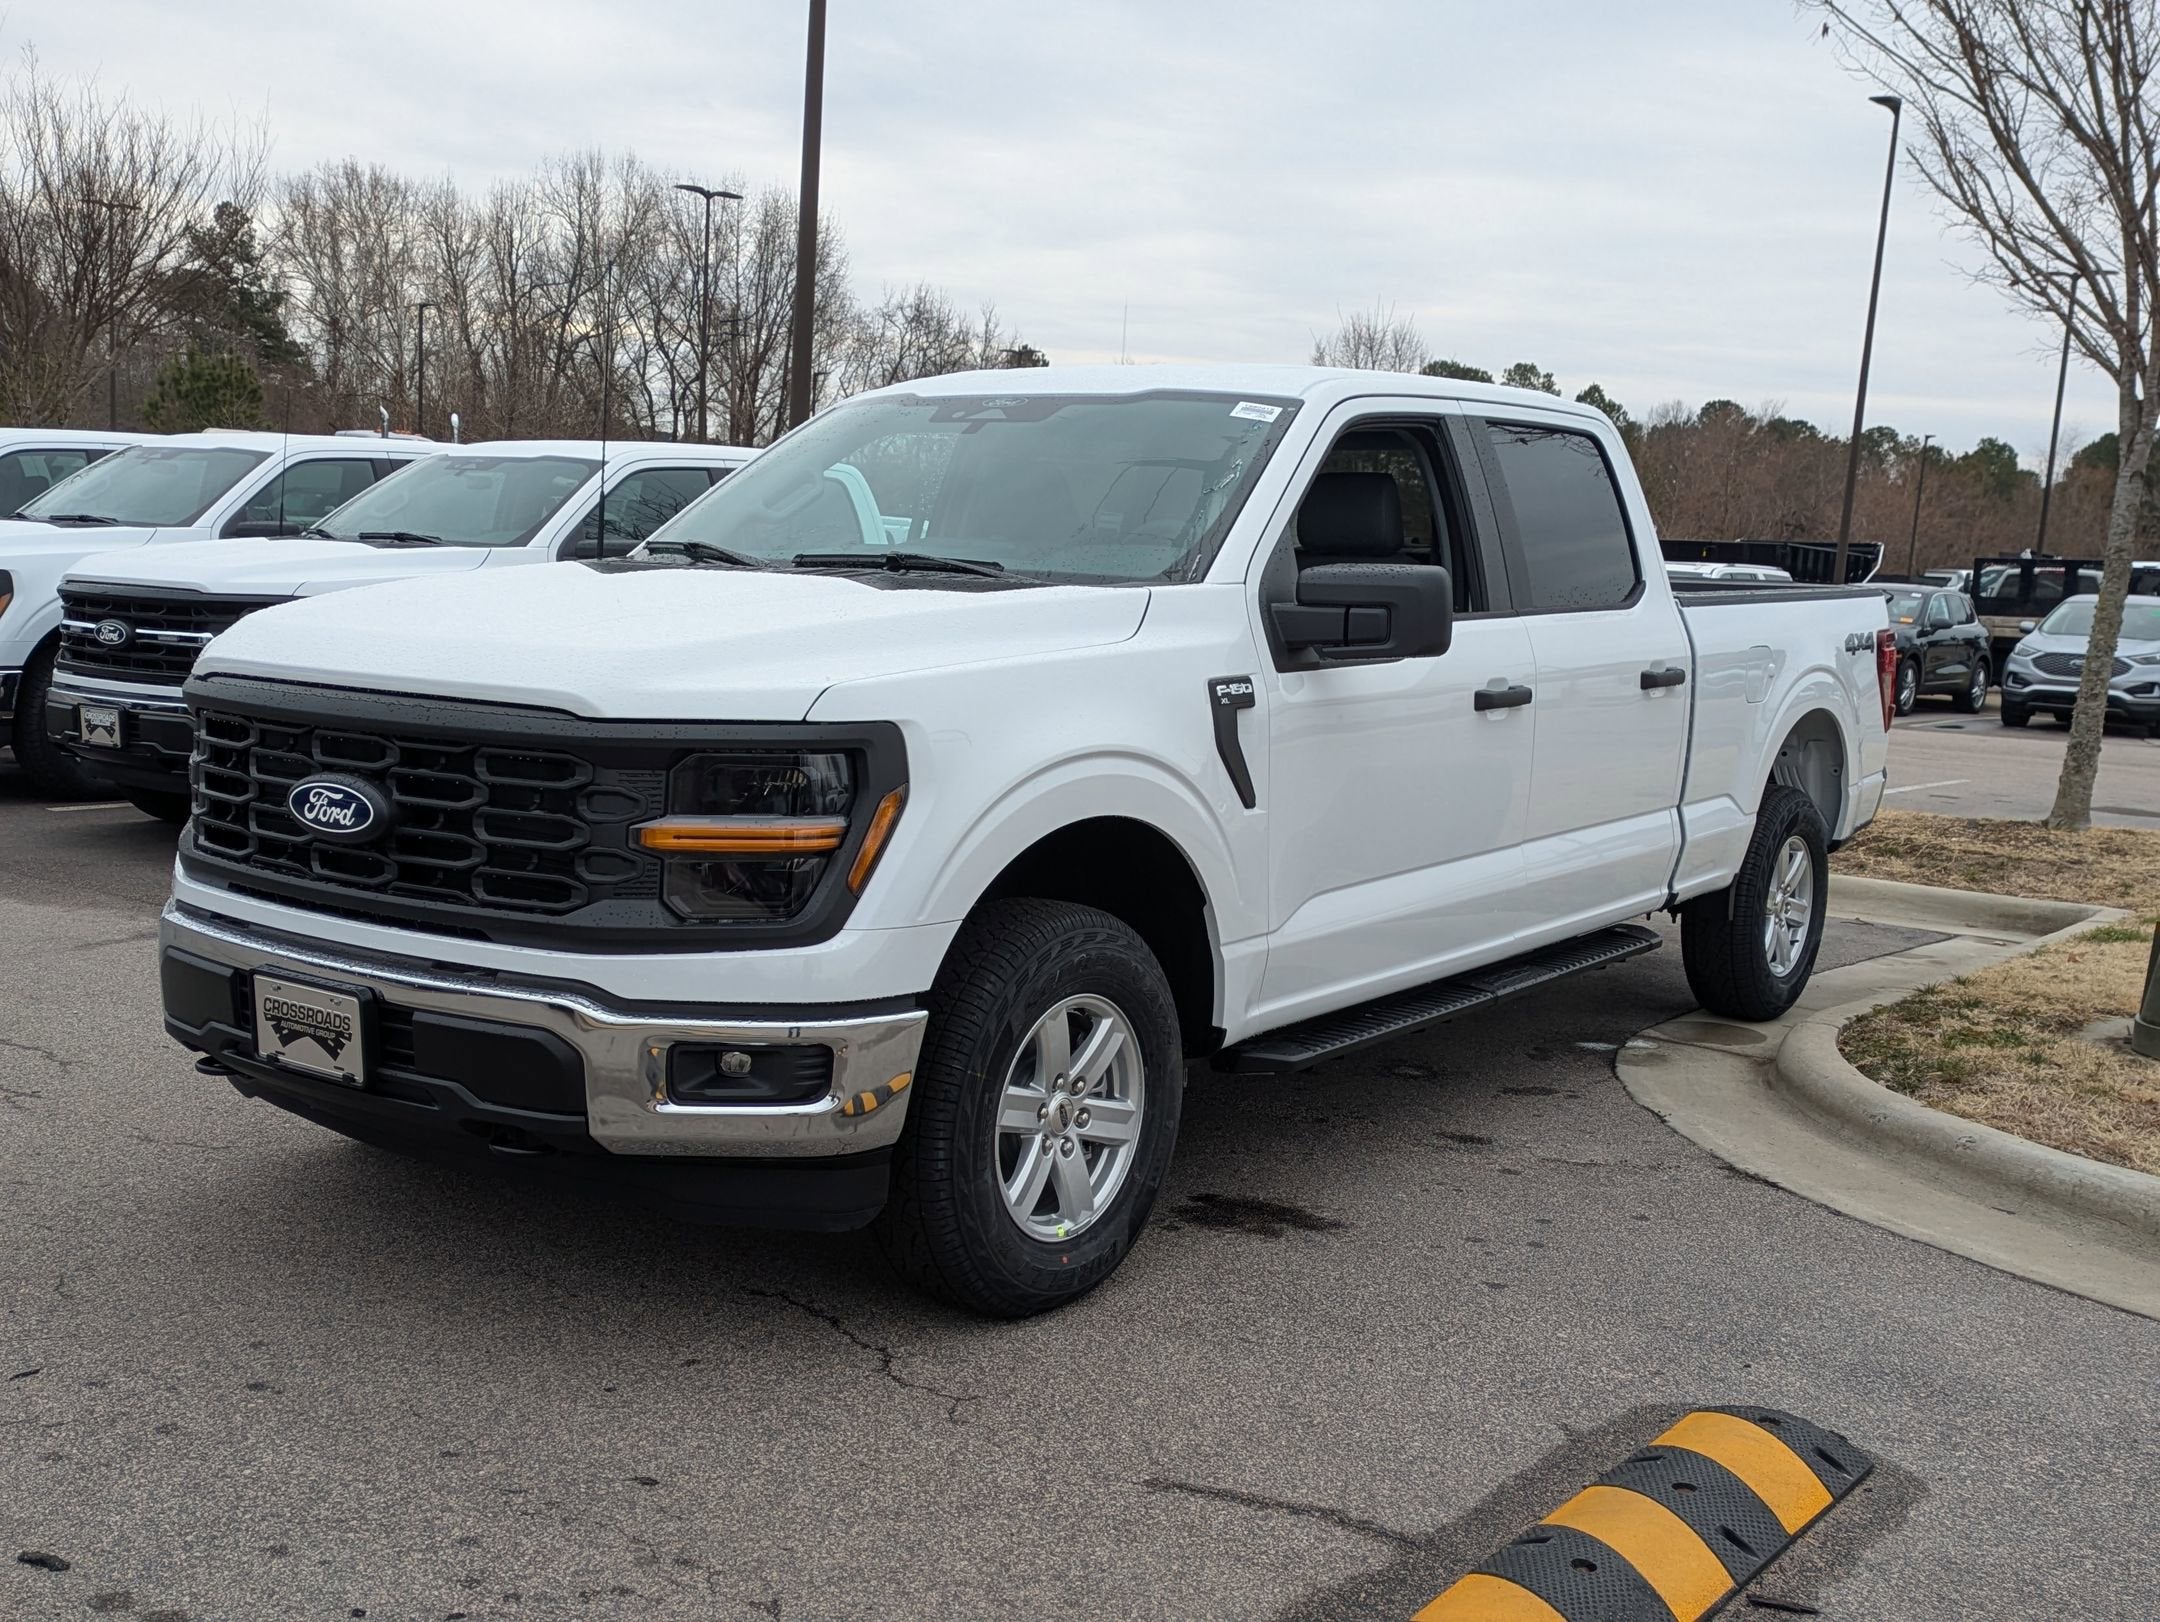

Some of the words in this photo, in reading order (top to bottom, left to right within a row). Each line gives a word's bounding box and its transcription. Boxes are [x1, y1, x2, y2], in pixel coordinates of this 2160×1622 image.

[100, 625, 119, 641] Ford
[1216, 683, 1253, 696] F-150
[1220, 697, 1231, 705] XL
[304, 788, 357, 826] Ford
[263, 996, 352, 1032] CROSSROADS
[280, 1020, 316, 1035] AUTOMOTIVE
[315, 1027, 336, 1039] GROUP
